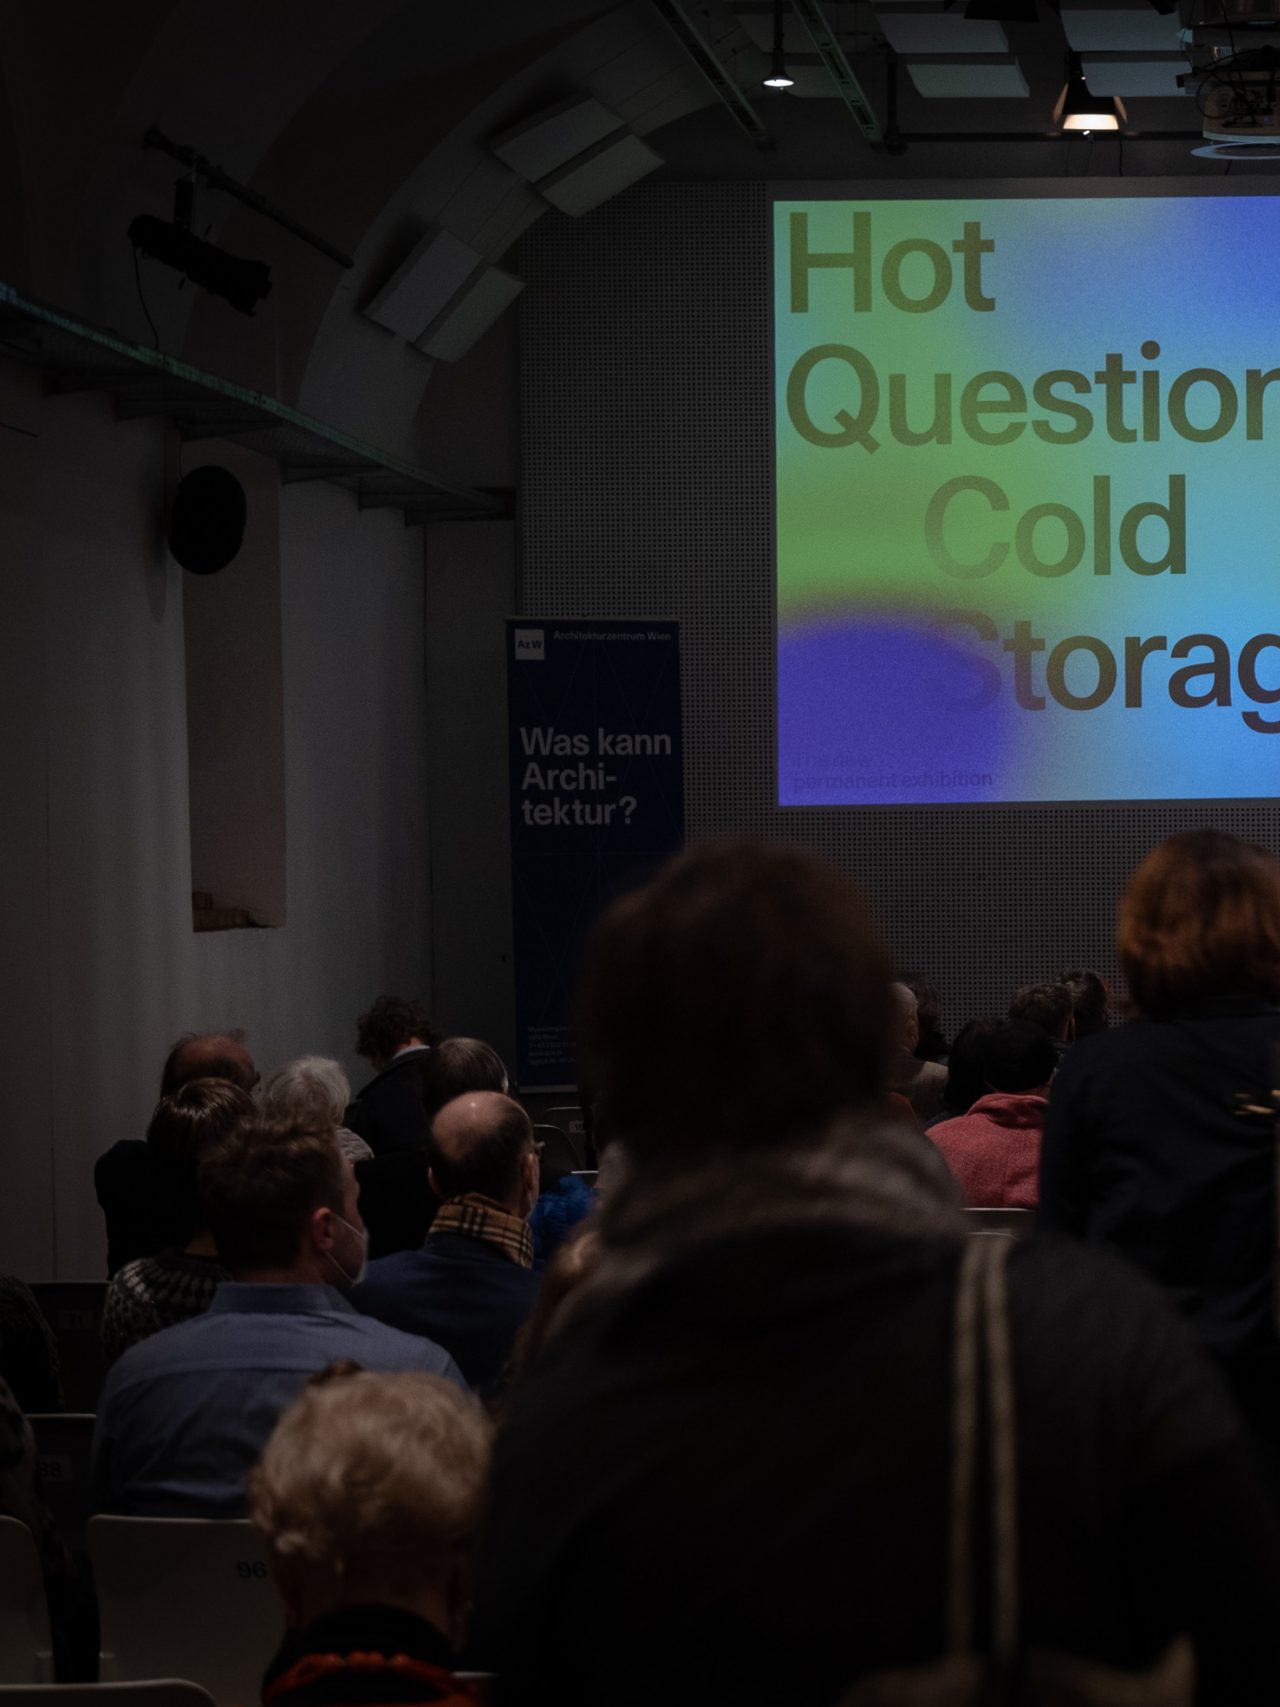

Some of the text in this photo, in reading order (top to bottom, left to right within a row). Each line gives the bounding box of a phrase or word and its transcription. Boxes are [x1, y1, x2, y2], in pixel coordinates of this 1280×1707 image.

[789, 211, 996, 314] Hot
[924, 474, 1187, 580] Cold
[518, 640, 542, 649] Az W
[553, 630, 671, 641] Architekturzentrum Wien
[520, 727, 672, 756] Was kann
[521, 762, 617, 791] Archi-
[793, 771, 993, 794] permanent exhibition
[521, 795, 638, 826] tektur?
[237, 1560, 267, 1578] 96
